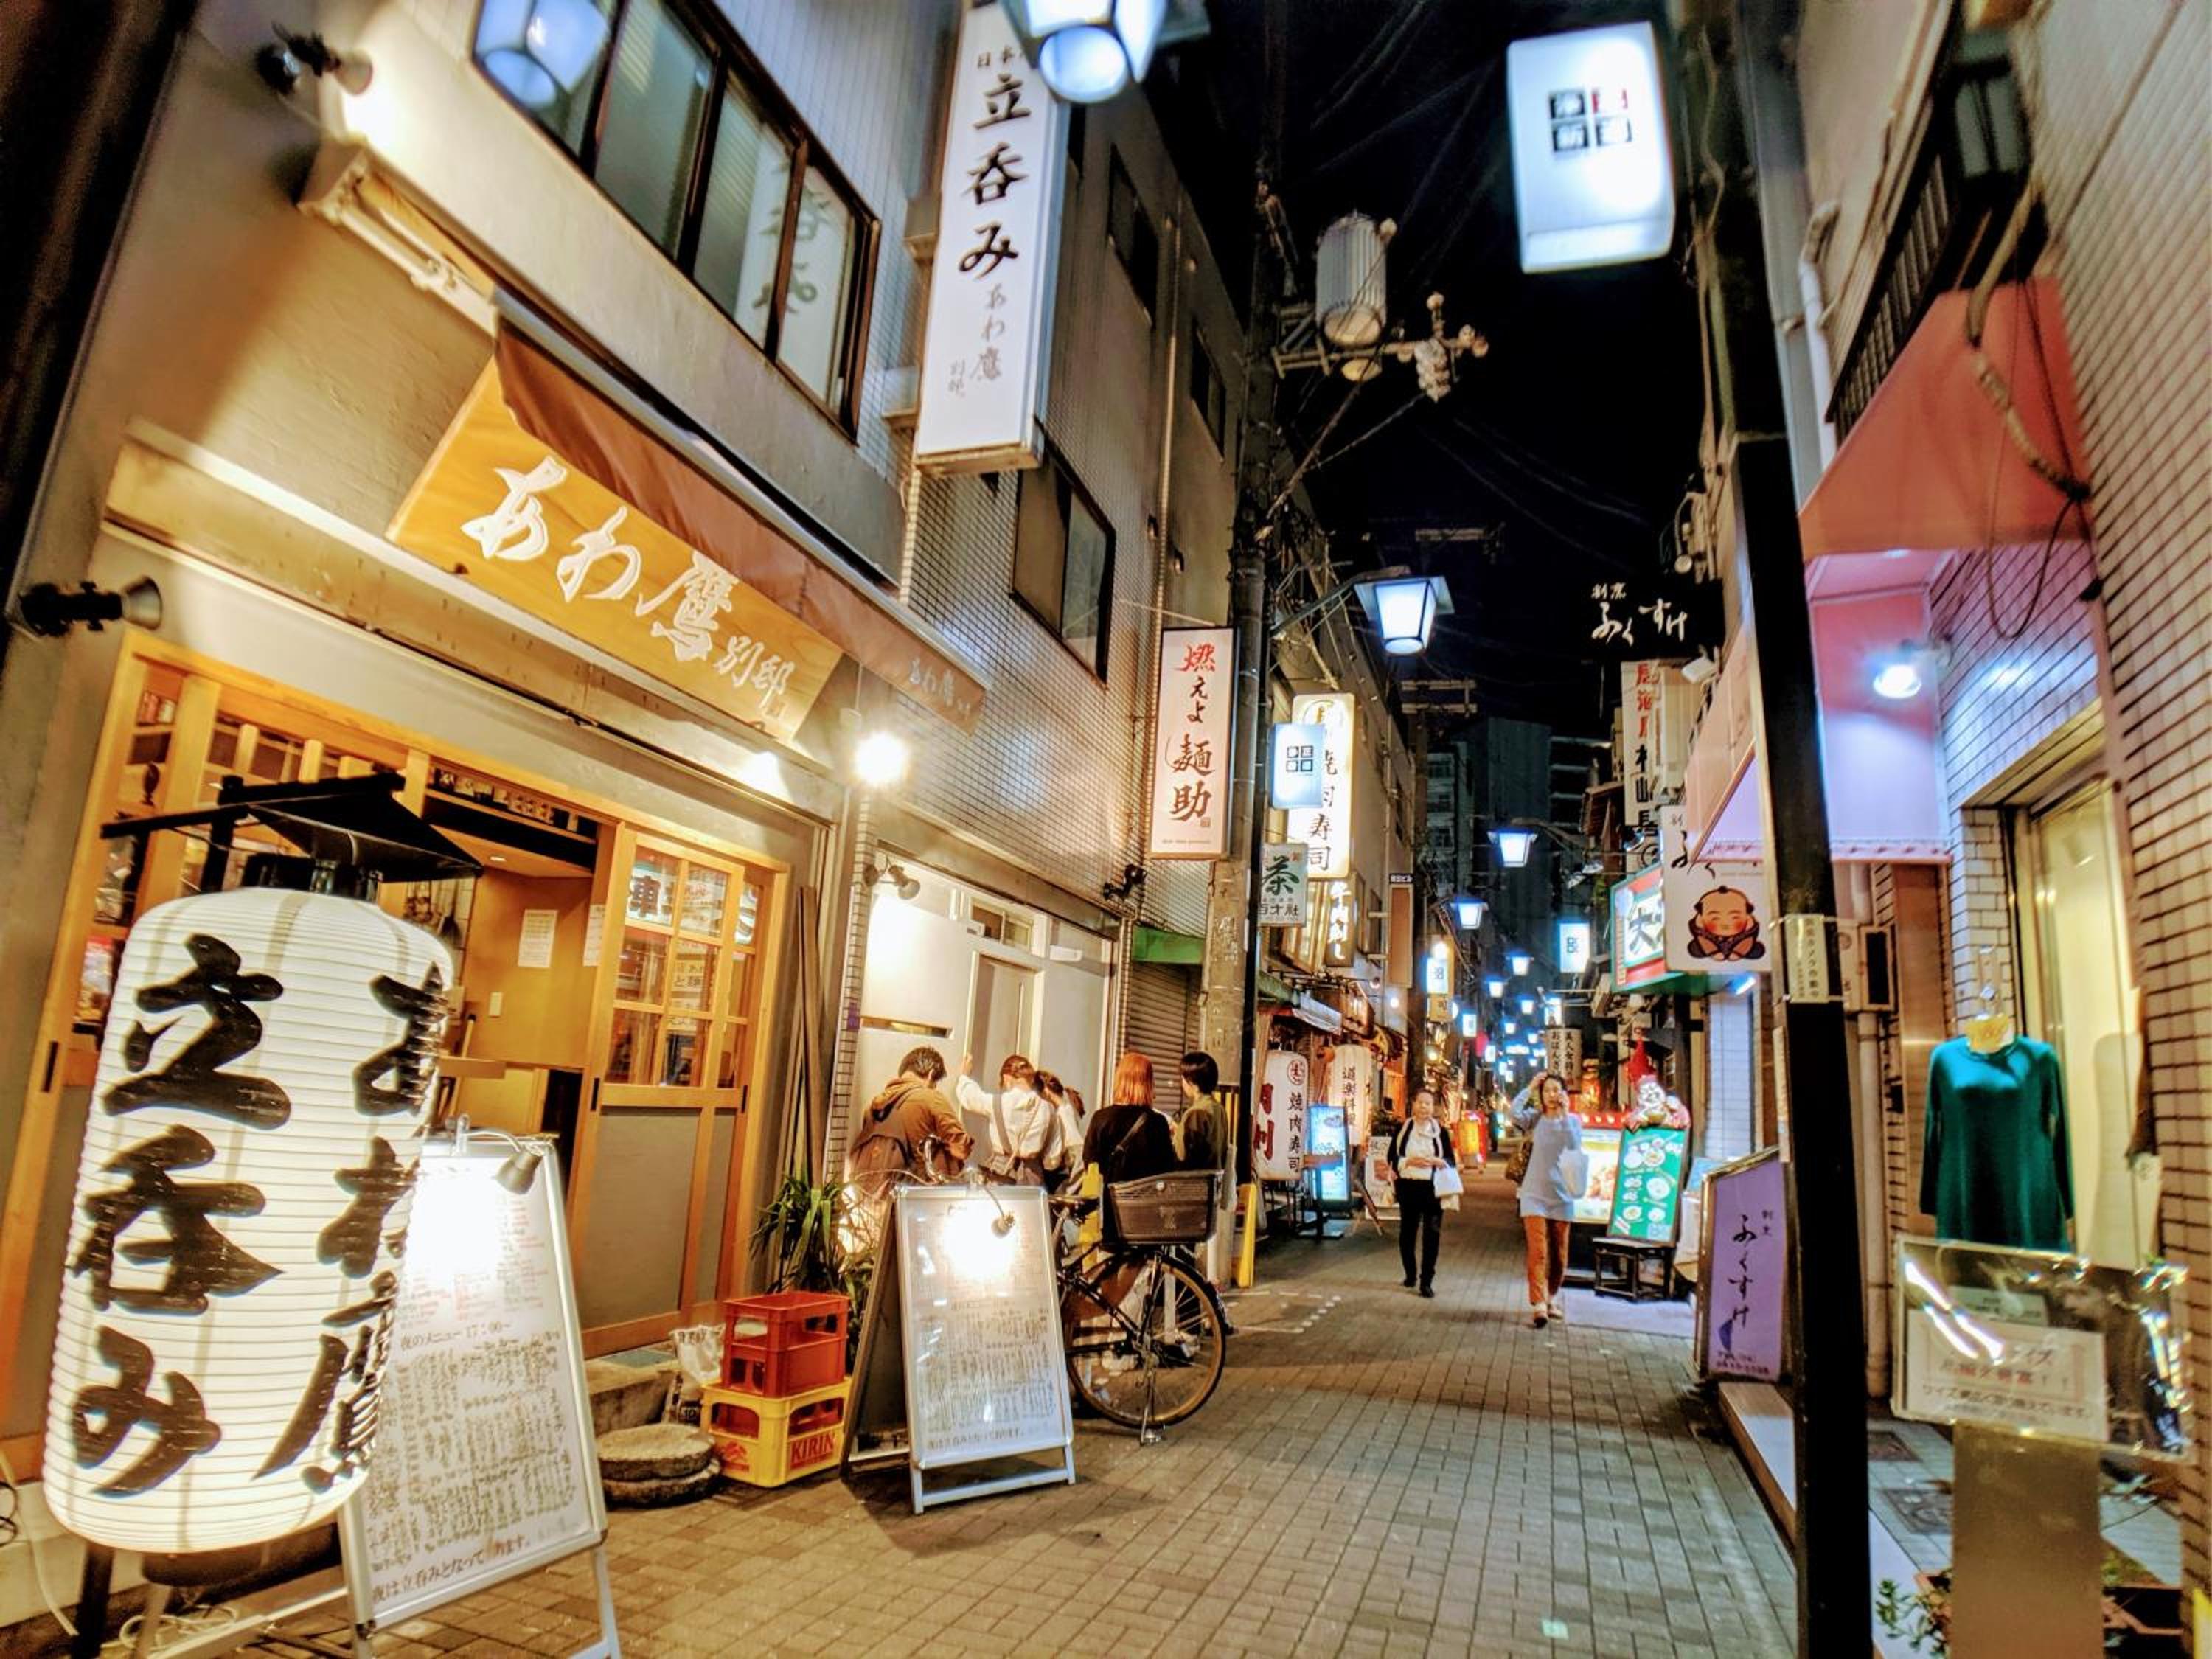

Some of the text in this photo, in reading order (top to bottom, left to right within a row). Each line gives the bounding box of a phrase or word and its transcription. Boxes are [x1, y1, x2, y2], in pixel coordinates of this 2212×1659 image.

[959, 72, 1030, 280] 立呑み
[460, 455, 740, 663] あわ鷹
[1262, 855, 1300, 896] 茶
[65, 932, 293, 1499] 立呑み
[1728, 1214, 1758, 1329] ふくすけ
[790, 1431, 837, 1464] KIRIN
